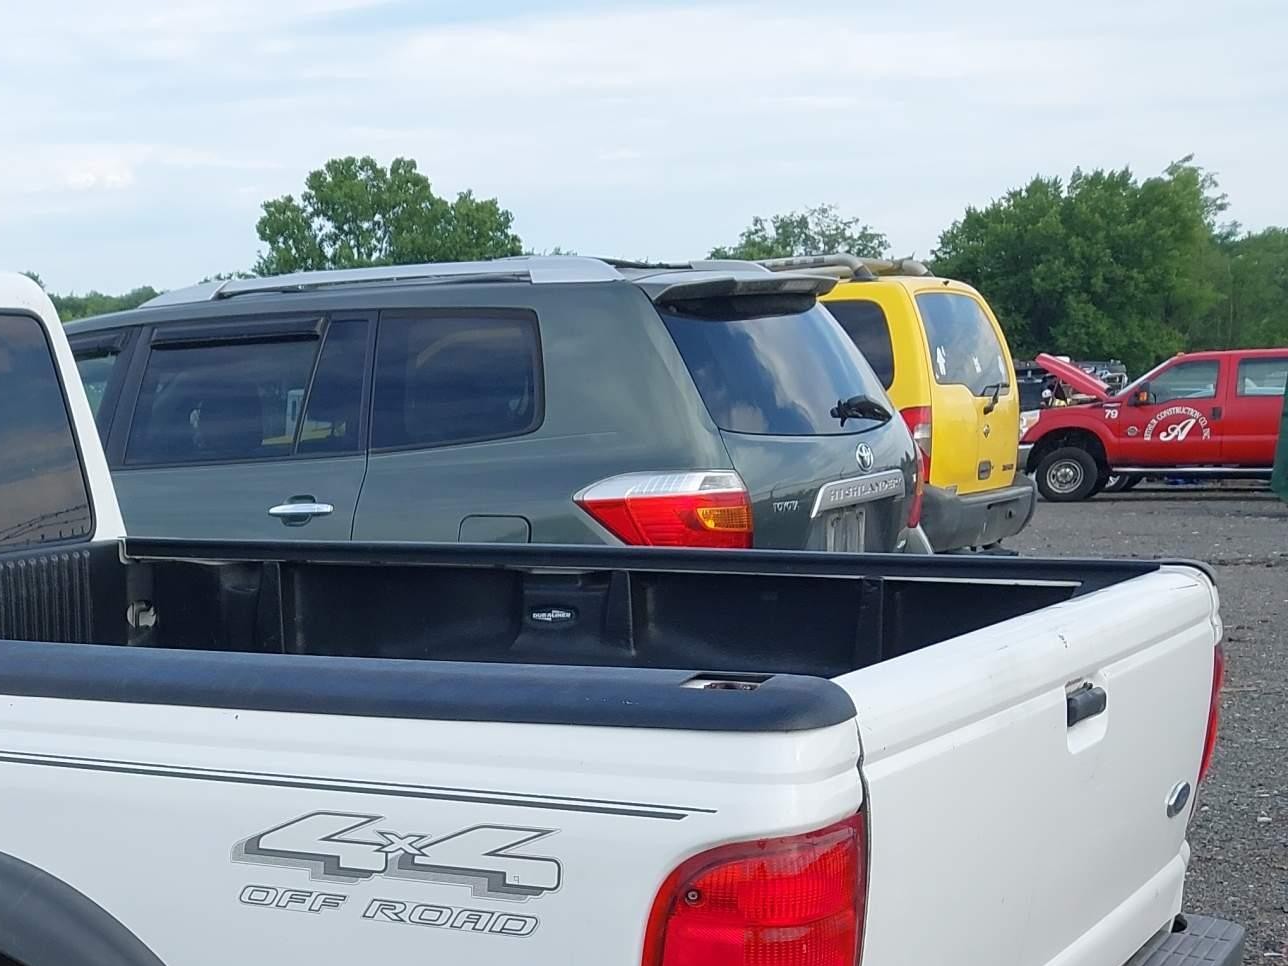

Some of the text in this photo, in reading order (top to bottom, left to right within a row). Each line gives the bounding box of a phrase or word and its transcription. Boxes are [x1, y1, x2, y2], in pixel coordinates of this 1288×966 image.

[1104, 409, 1119, 419] 79
[1159, 418, 1197, 442] A
[239, 885, 540, 938] OFF ROAD
